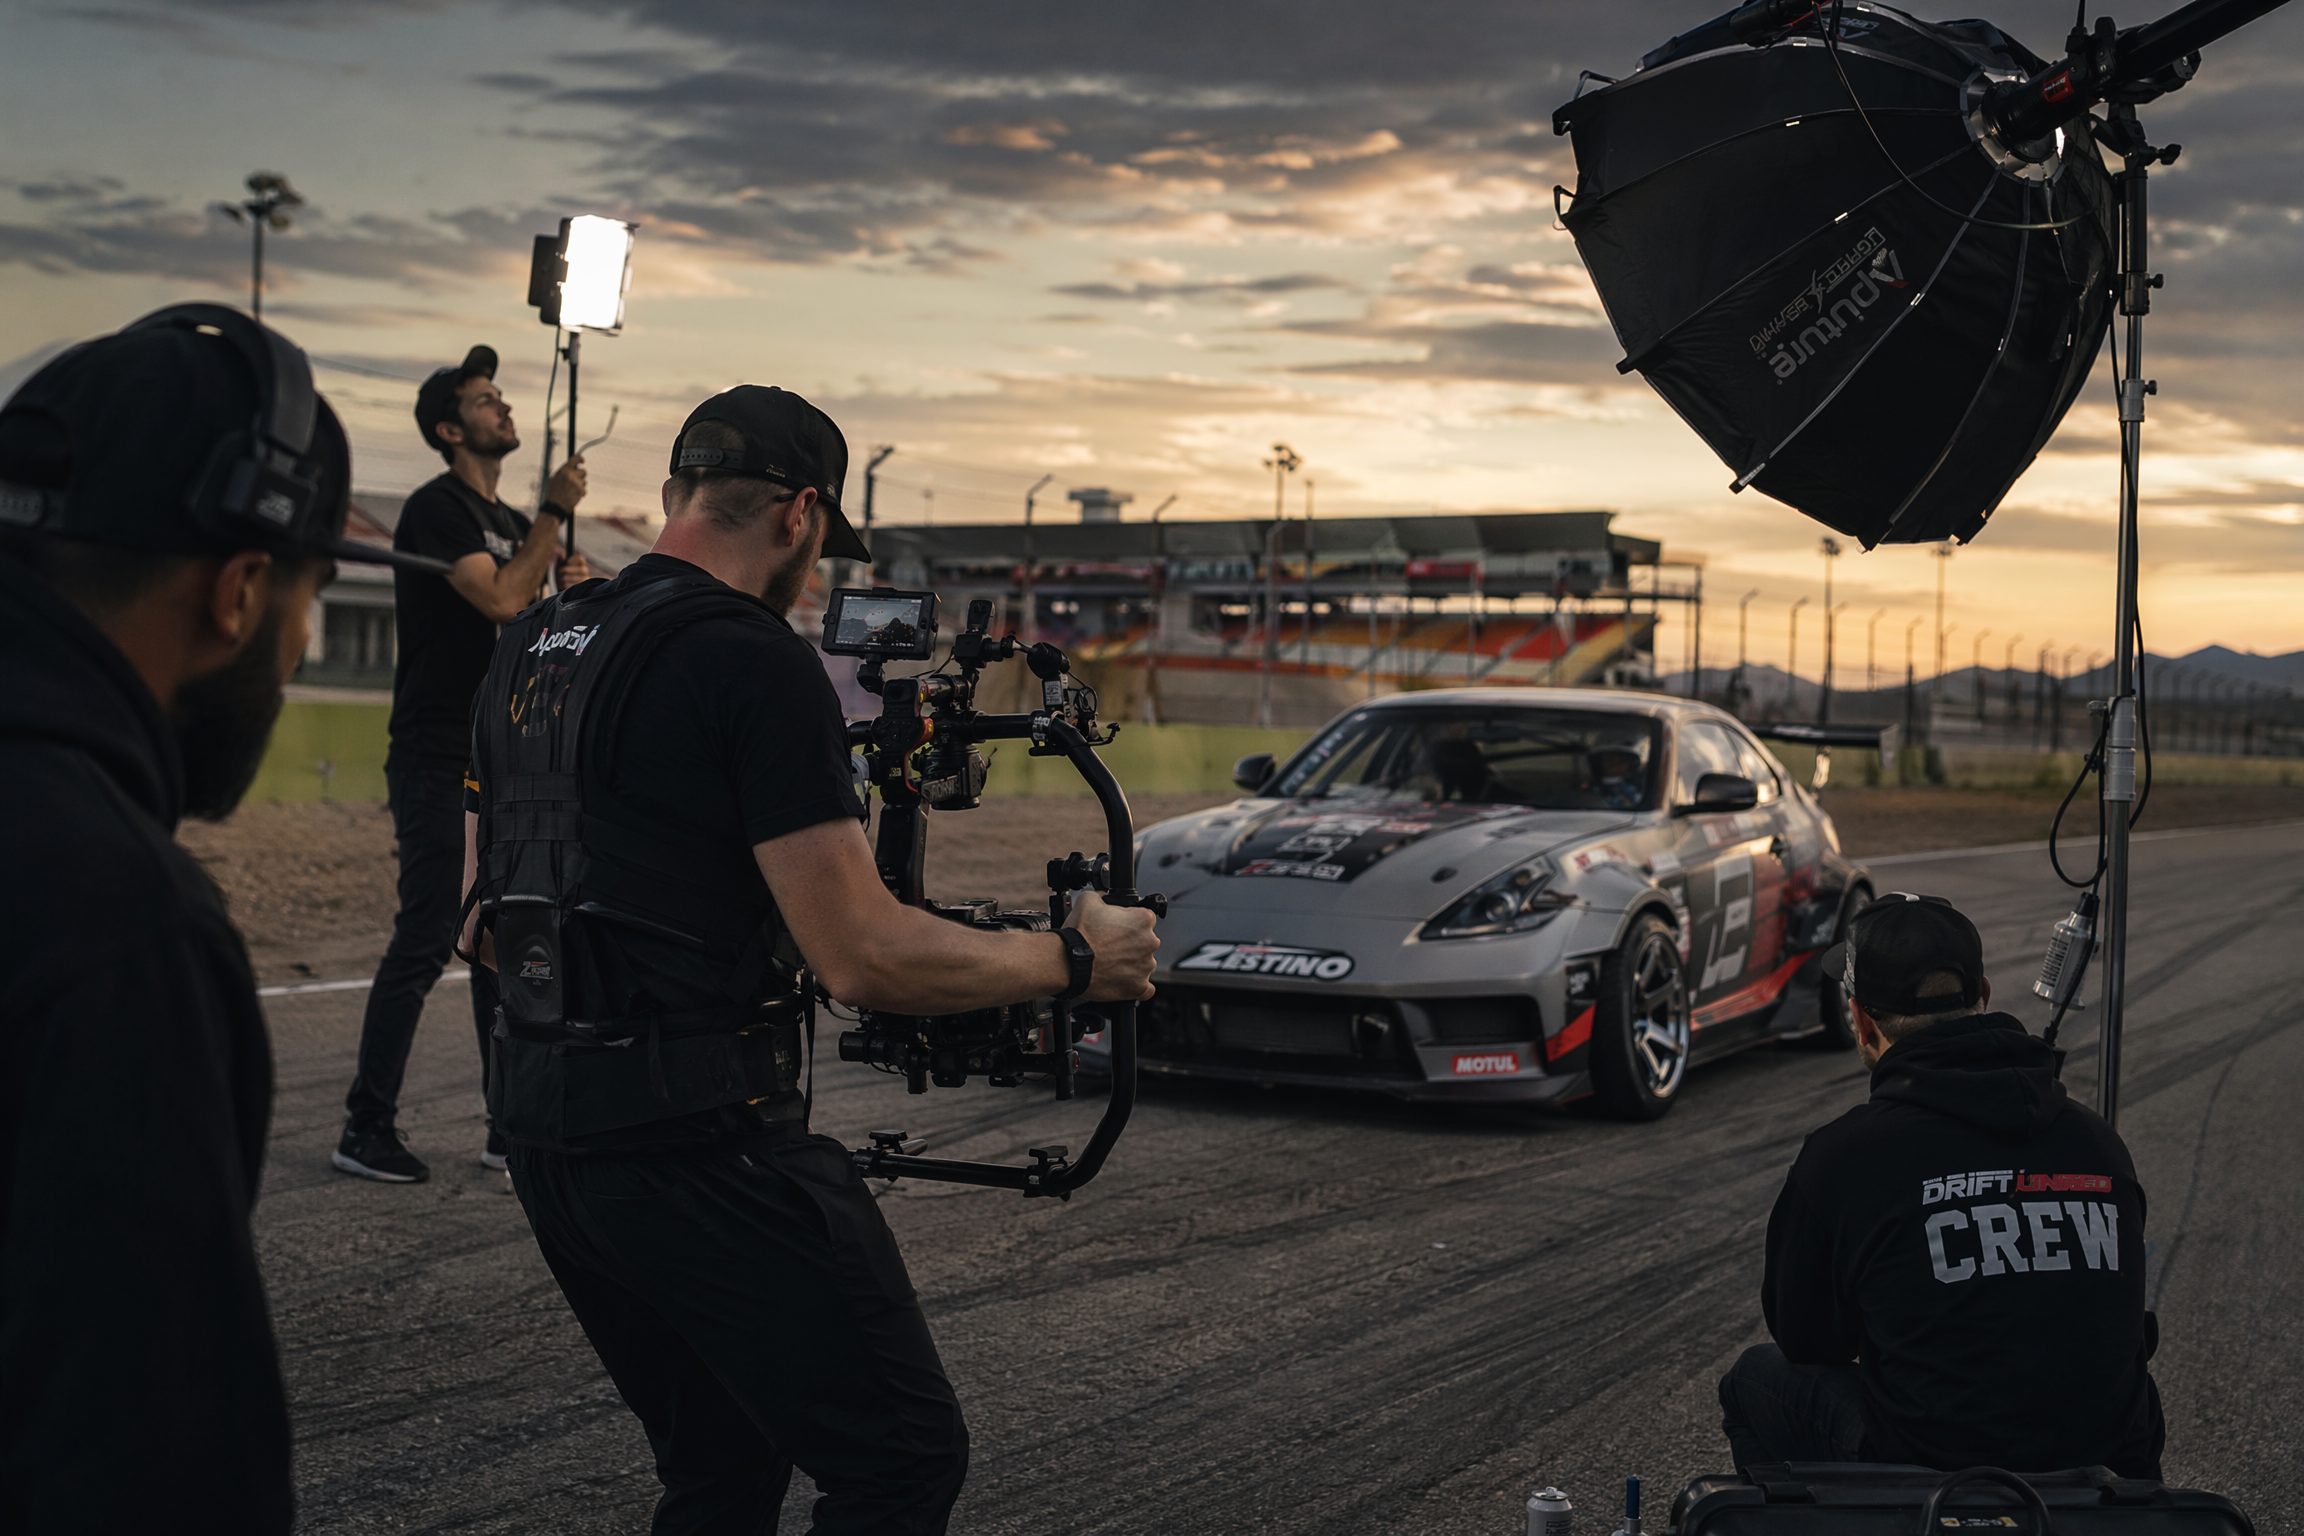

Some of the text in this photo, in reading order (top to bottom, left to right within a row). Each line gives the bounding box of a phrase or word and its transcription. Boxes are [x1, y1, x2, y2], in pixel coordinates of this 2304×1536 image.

[1768, 248, 1910, 379] Aputure
[1177, 944, 1353, 979] ZESTINO
[1456, 1055, 1516, 1072] MOTUL
[1921, 1168, 2112, 1205] DRIFT UNED
[1924, 1201, 2120, 1284] CREW
